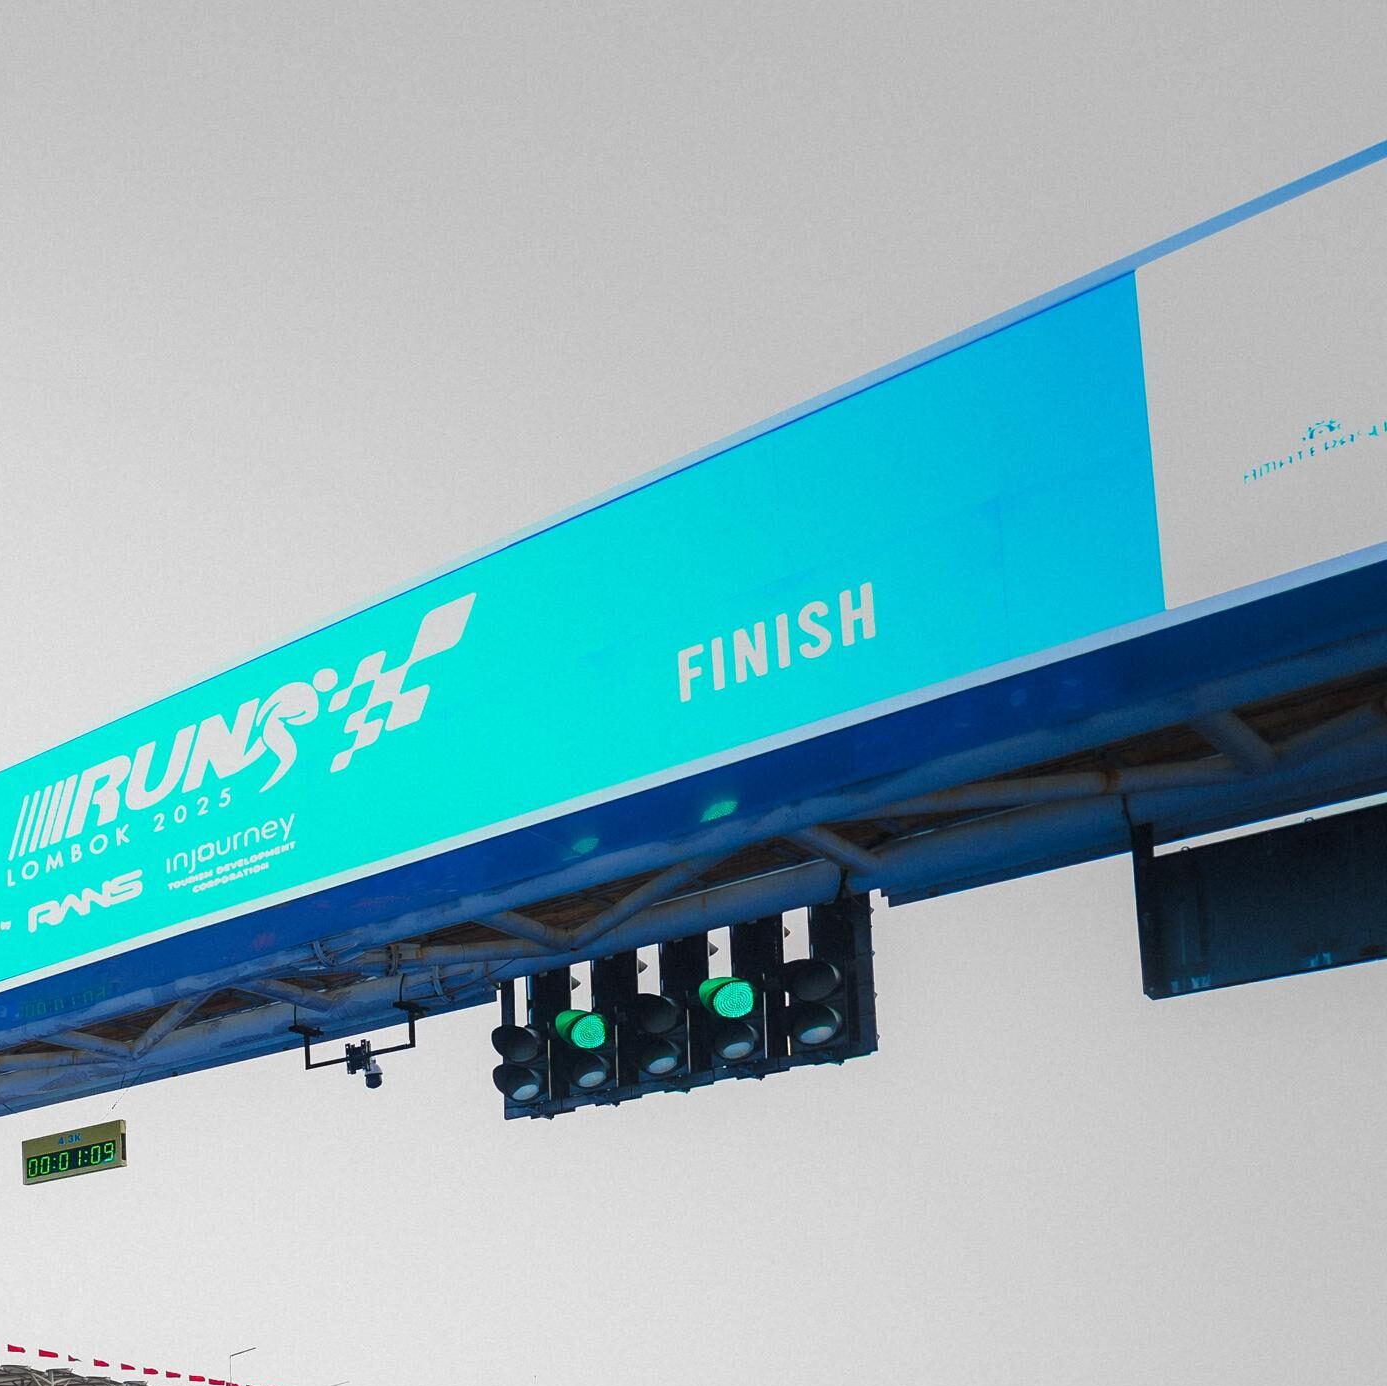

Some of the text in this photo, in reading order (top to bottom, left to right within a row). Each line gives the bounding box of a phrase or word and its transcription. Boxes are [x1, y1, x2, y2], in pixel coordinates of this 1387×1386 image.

[677, 582, 877, 703] FINISH
[6, 788, 232, 887] LOMBOK 2025
[27, 868, 143, 933] RANS
[28, 1142, 115, 1177] 00:01:09
